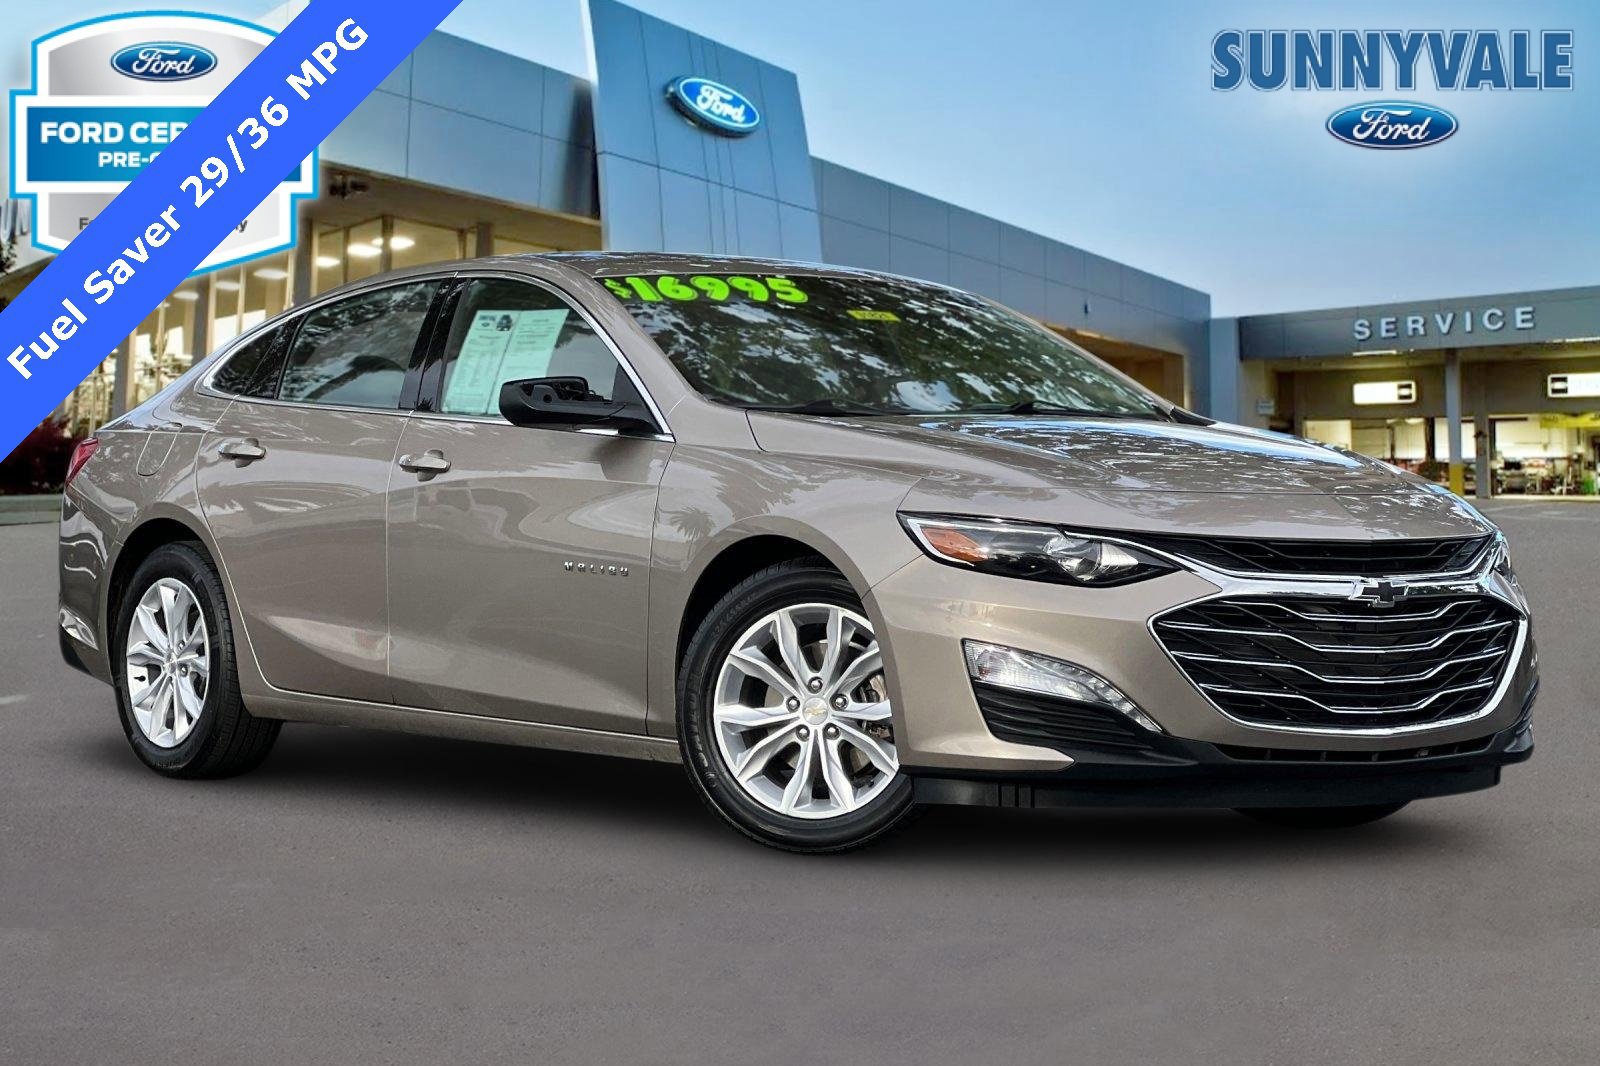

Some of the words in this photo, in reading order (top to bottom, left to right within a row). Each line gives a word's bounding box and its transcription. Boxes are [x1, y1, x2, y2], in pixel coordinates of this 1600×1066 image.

[696, 84, 746, 123] Ford
[604, 275, 808, 303] $16995
[1353, 306, 1536, 341] SERVICE
